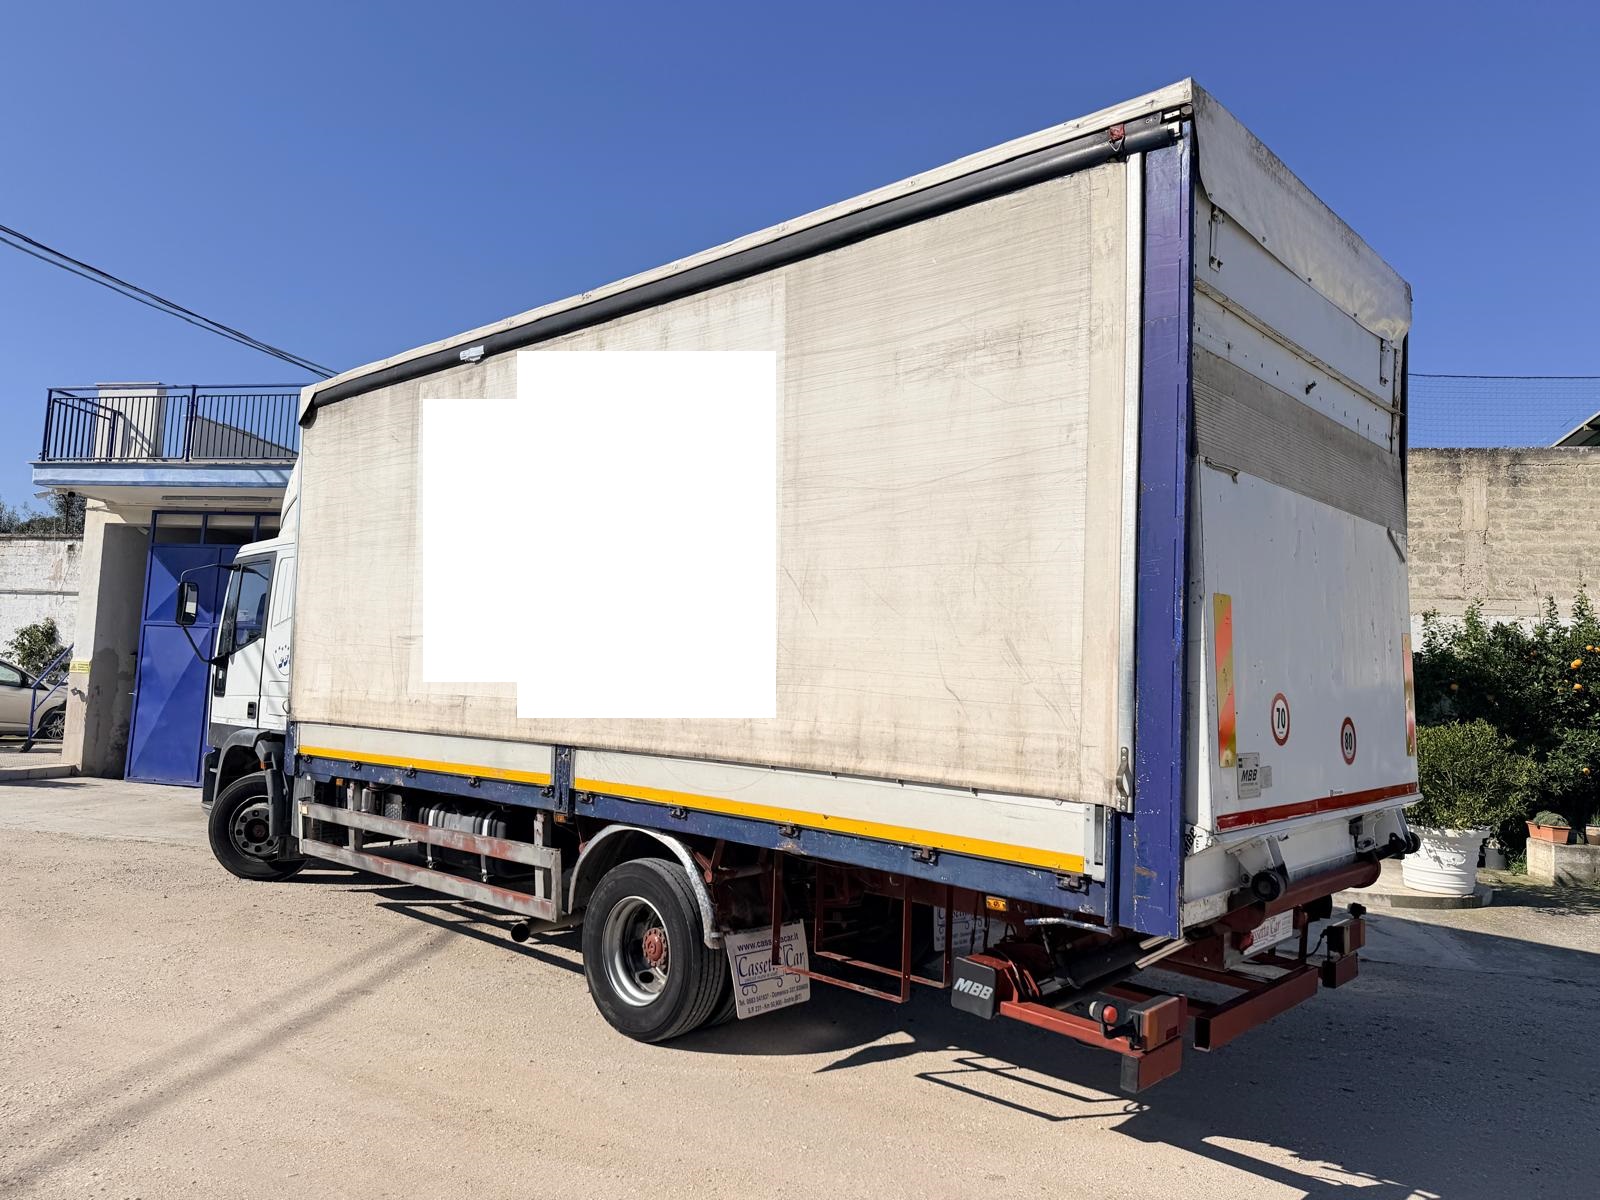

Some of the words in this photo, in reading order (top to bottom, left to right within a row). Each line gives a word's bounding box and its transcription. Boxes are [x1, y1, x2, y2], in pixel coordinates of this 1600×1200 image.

[1276, 707, 1286, 729] 70
[1344, 731, 1353, 751] 80
[1241, 769, 1258, 782] MBB
[737, 932, 799, 951] www.cassacar.it
[786, 948, 804, 968] Car
[953, 977, 994, 1000] MBB
